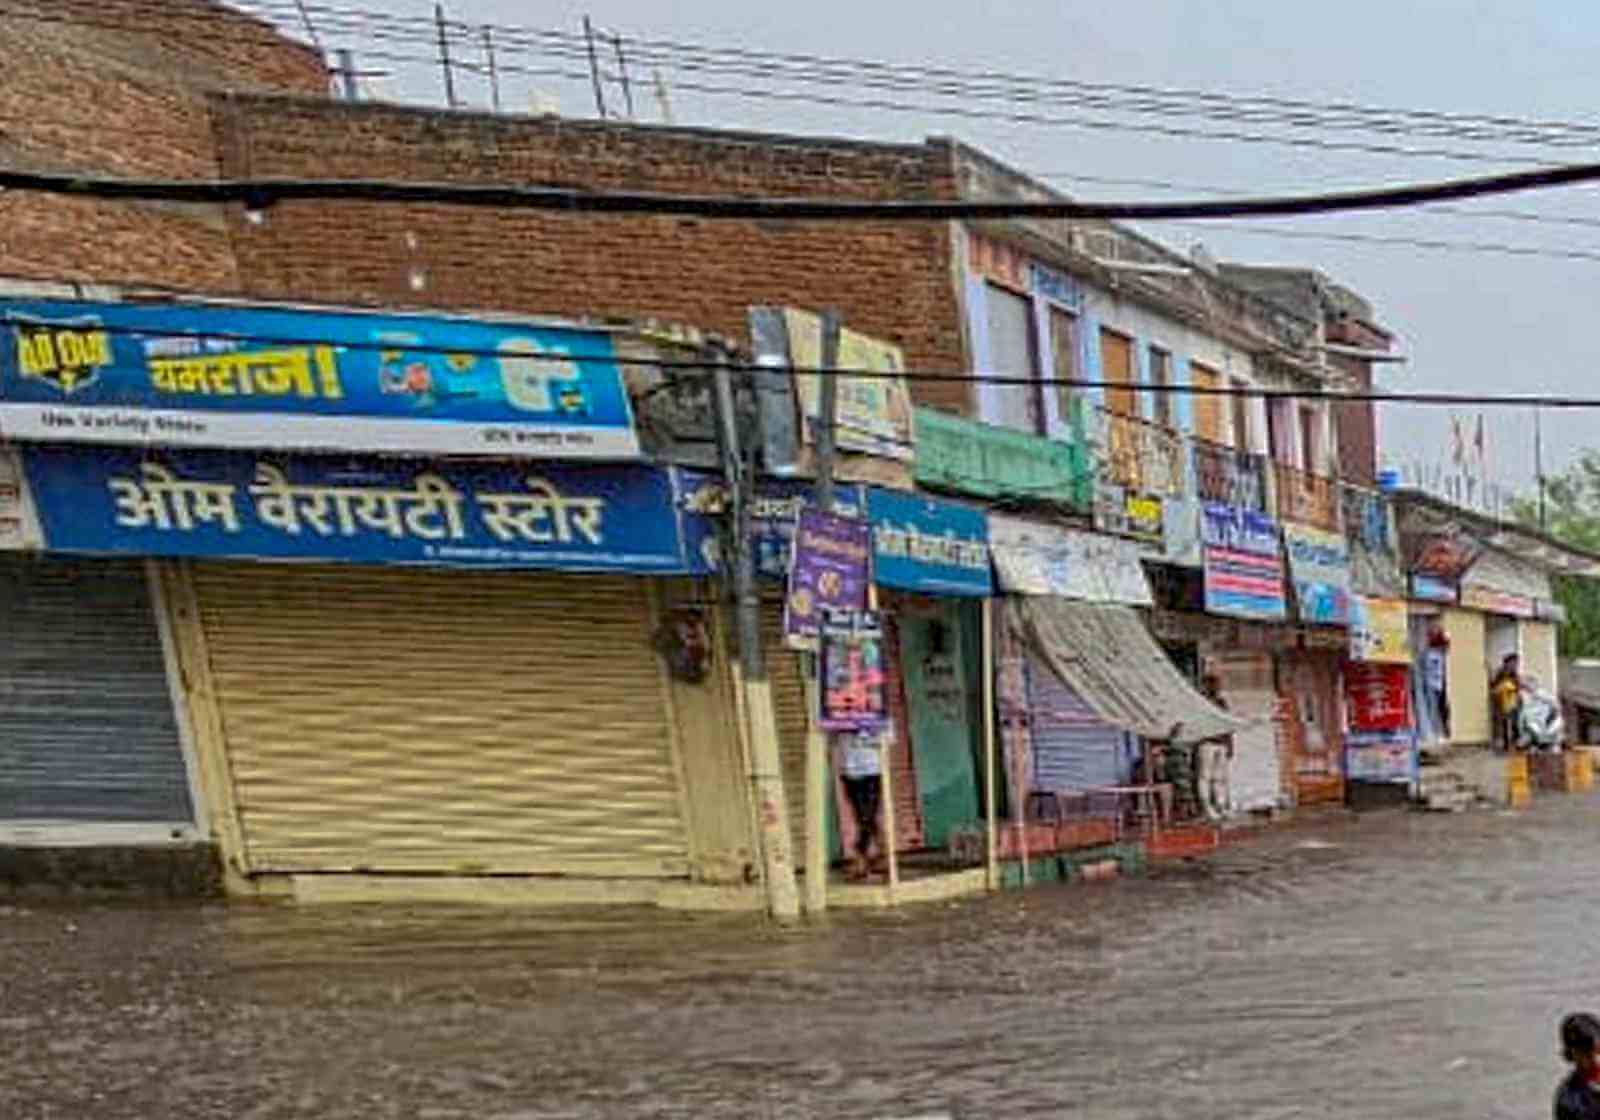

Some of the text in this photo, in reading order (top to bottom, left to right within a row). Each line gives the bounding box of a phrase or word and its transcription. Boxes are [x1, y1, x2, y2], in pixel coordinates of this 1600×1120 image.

[108, 460, 239, 531] ओम
[249, 461, 465, 539] वैरायटी
[475, 476, 606, 545] स्टोर
